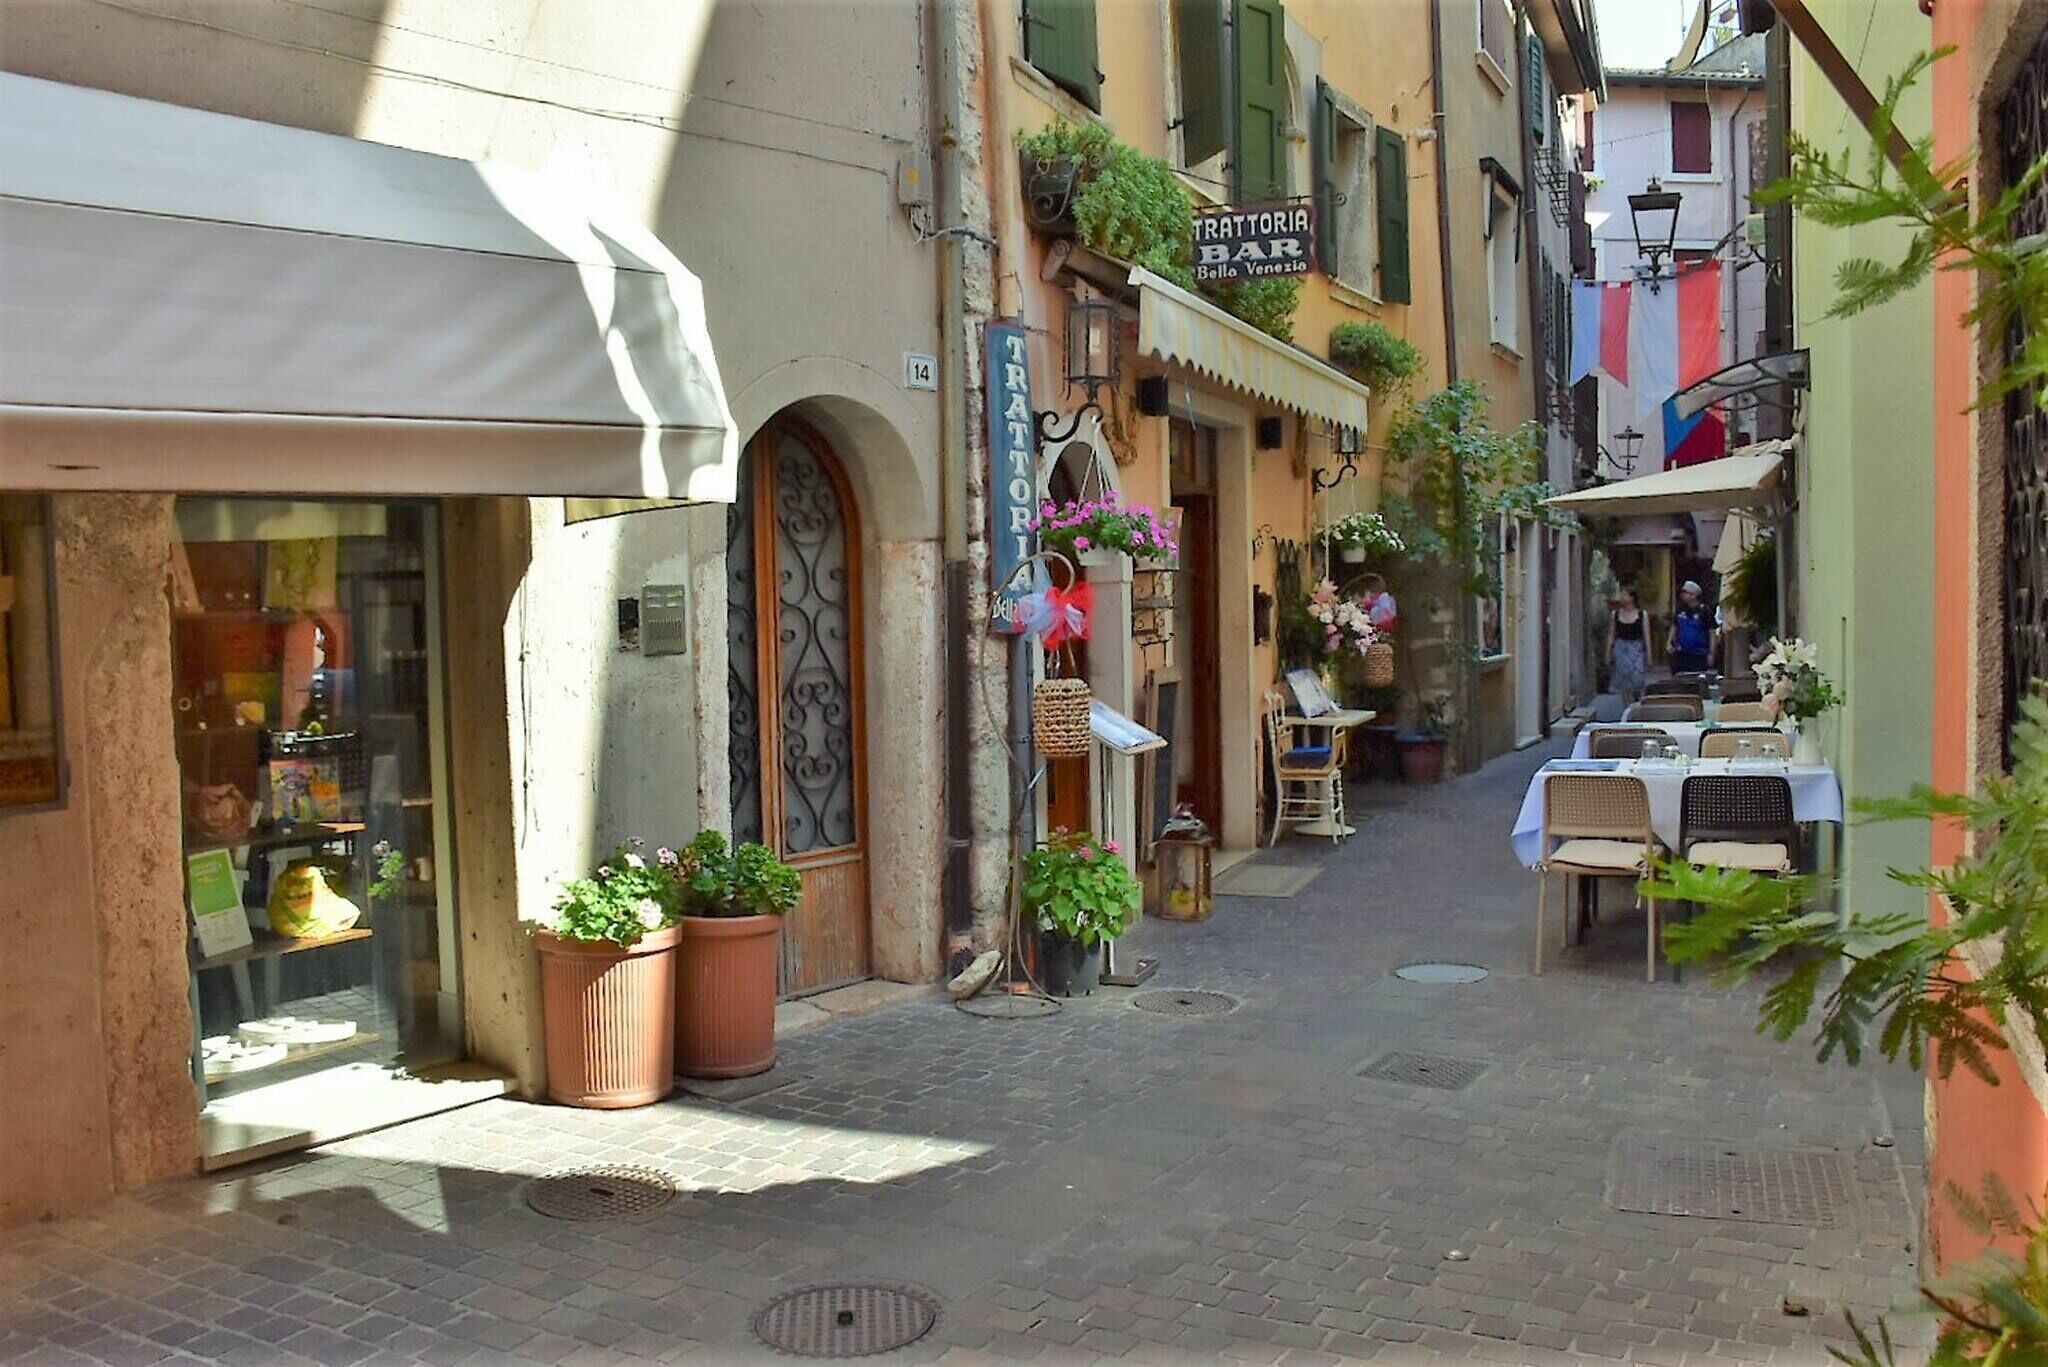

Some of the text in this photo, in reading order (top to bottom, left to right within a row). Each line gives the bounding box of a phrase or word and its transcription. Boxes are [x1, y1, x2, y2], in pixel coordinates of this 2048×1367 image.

[1193, 208, 1308, 240] TRATTORIA
[1199, 238, 1304, 264] BAR
[1197, 260, 1308, 280] Bella Venezia
[914, 363, 930, 381] 14
[1003, 335, 1033, 592] TRATTORIA
